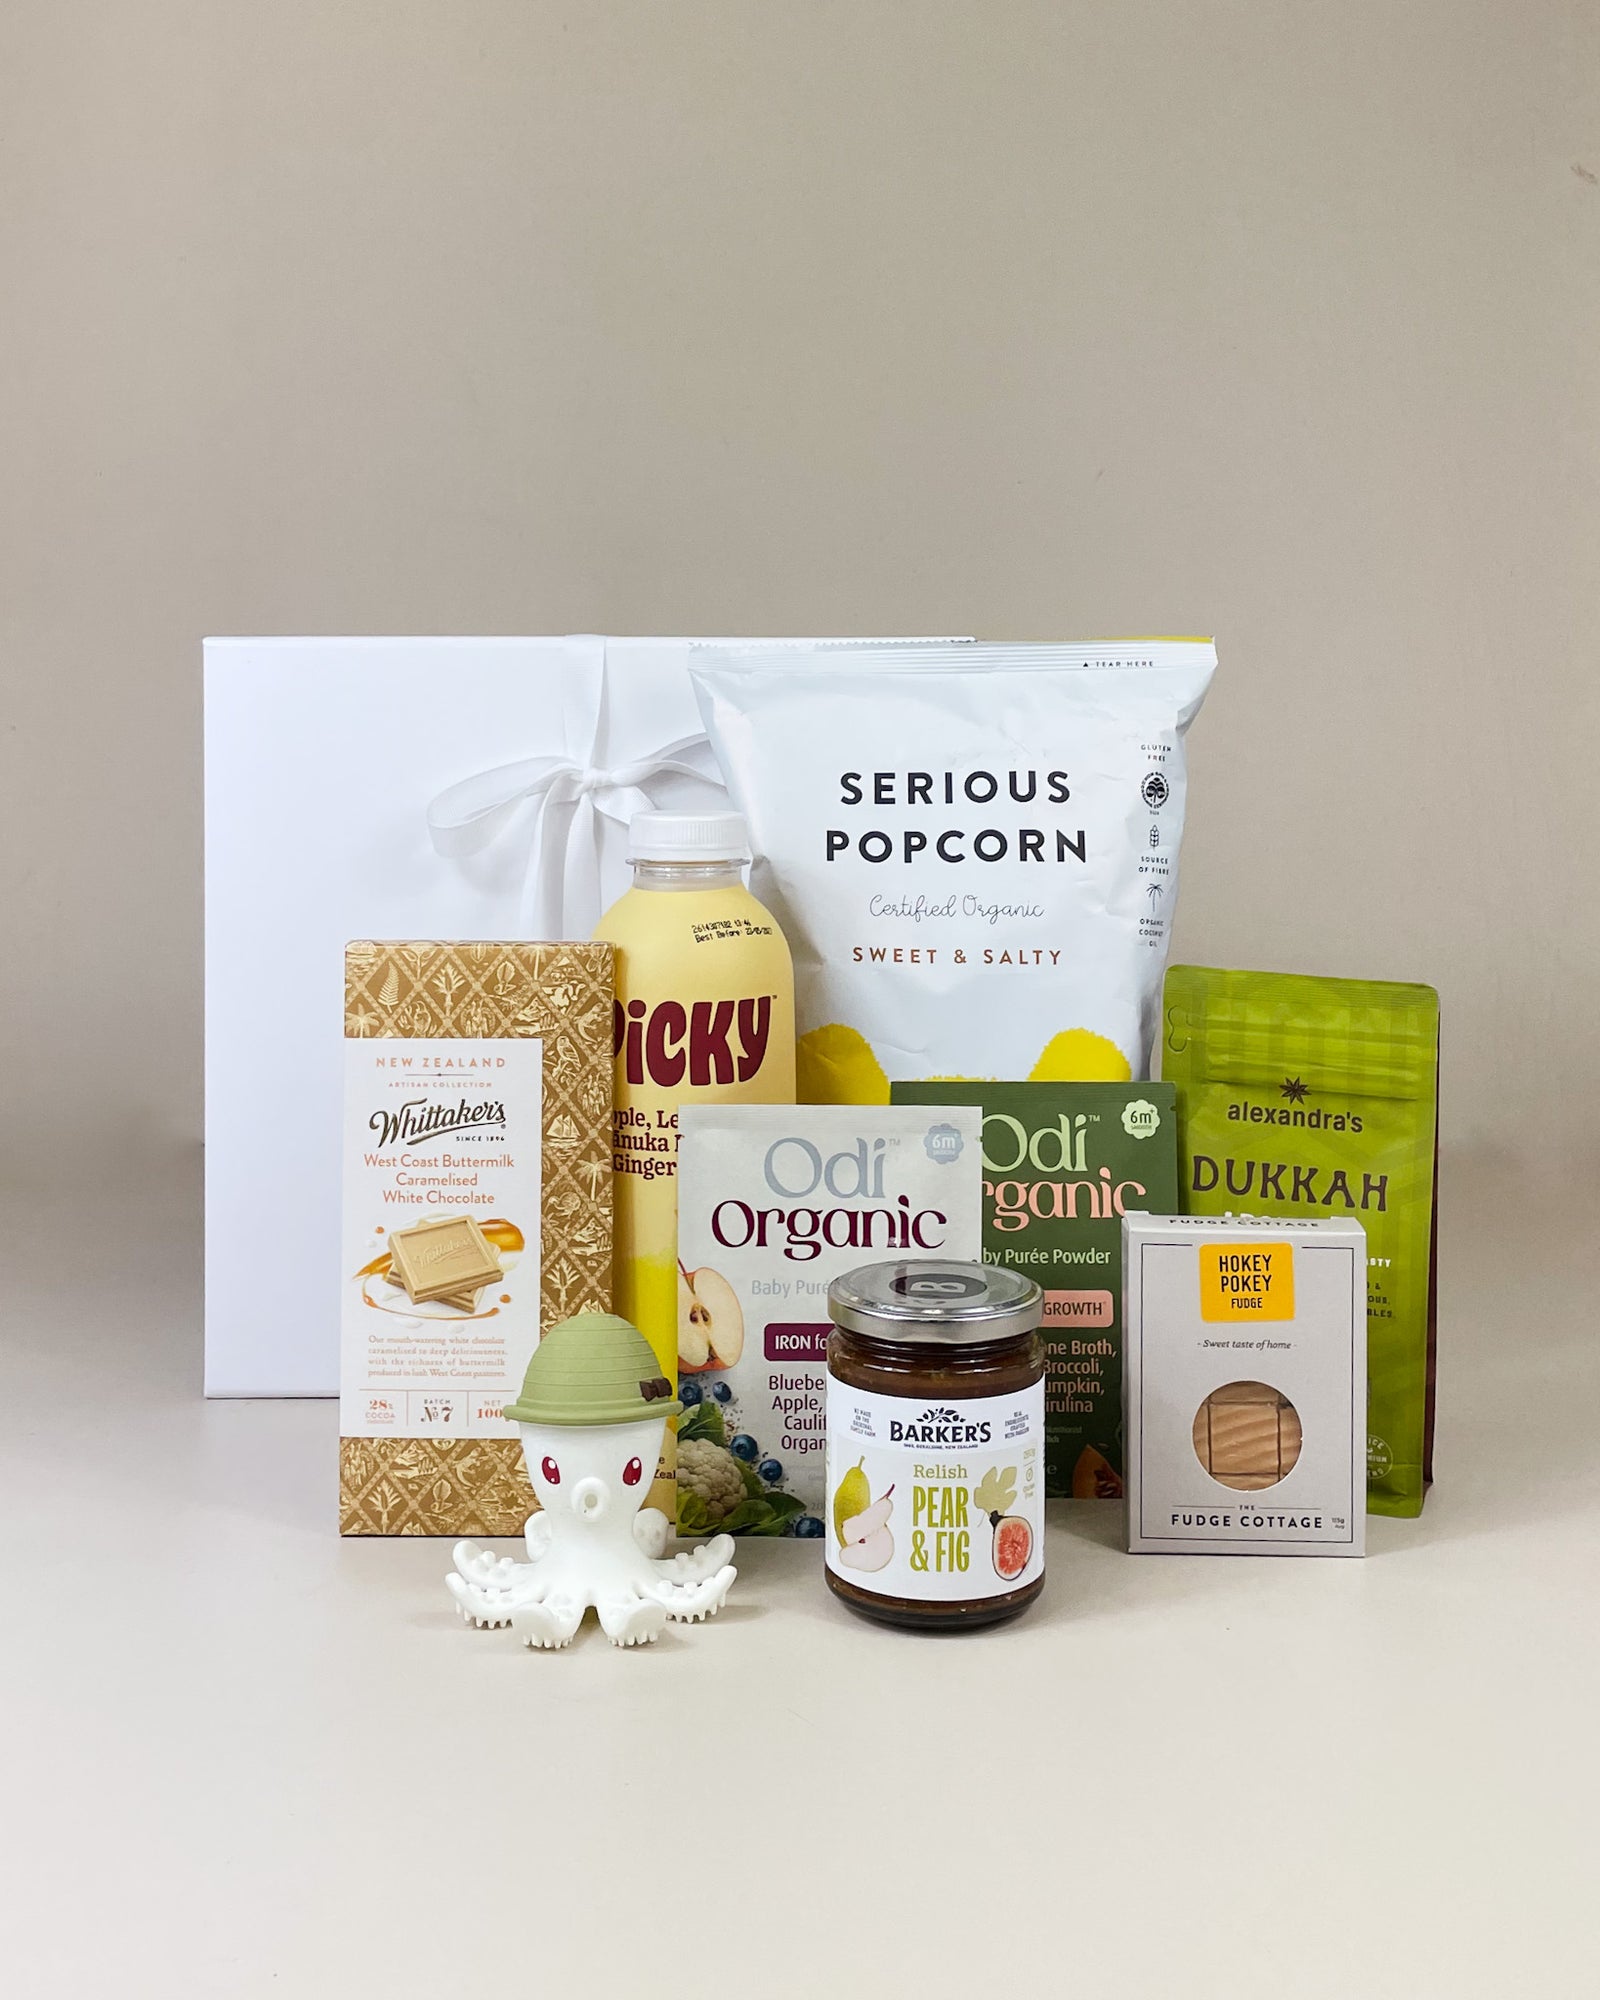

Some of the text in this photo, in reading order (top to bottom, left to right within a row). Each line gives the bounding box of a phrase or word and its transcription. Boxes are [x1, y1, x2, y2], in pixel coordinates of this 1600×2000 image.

[840, 771, 1070, 805] SERIOUS
[826, 829, 1086, 863] POPCORN
[1141, 856, 1168, 864] SOURCE
[869, 894, 1045, 925] Certified Organic
[695, 933, 713, 943] Best
[853, 947, 1061, 965] SWEET & SALTY
[376, 1057, 506, 1067] NEW ZEALAND
[369, 1098, 506, 1148] Whittaker's
[657, 1110, 679, 1129] Le
[1227, 1101, 1364, 1134] alexandra's
[982, 1113, 1088, 1172] Odi
[364, 1154, 515, 1168] West Coast Buttermilk
[613, 1153, 678, 1180] Ginger
[764, 1137, 886, 1199] Odi
[396, 1172, 478, 1186] Caramelised
[1192, 1155, 1388, 1212] DUKKAH
[383, 1190, 495, 1204] White Chocolate
[711, 1194, 948, 1261] Organic
[983, 1247, 1112, 1266] by Purée Powder
[1219, 1254, 1273, 1273] HOKEY
[752, 1278, 829, 1300] Baby Puré
[1220, 1274, 1273, 1293] POKEY
[1044, 1302, 1102, 1316] GROWTH
[1231, 1297, 1263, 1309] FUDGE
[775, 1334, 828, 1350] IRON fo
[1047, 1338, 1117, 1358] ne Broth,
[1202, 1339, 1292, 1351] Sweet taste of home
[769, 1373, 826, 1391] Bluebe
[772, 1394, 823, 1415] Apple,
[1046, 1396, 1094, 1413] irulina
[890, 1420, 992, 1443] BARKER'S
[781, 1434, 827, 1455] Organ
[654, 1469, 676, 1480] Zeal
[913, 1464, 968, 1479] Relish
[913, 1486, 969, 1528] PEAR
[1171, 1514, 1322, 1529] FUDGE COTTAGE
[910, 1530, 970, 1572] & FIG
